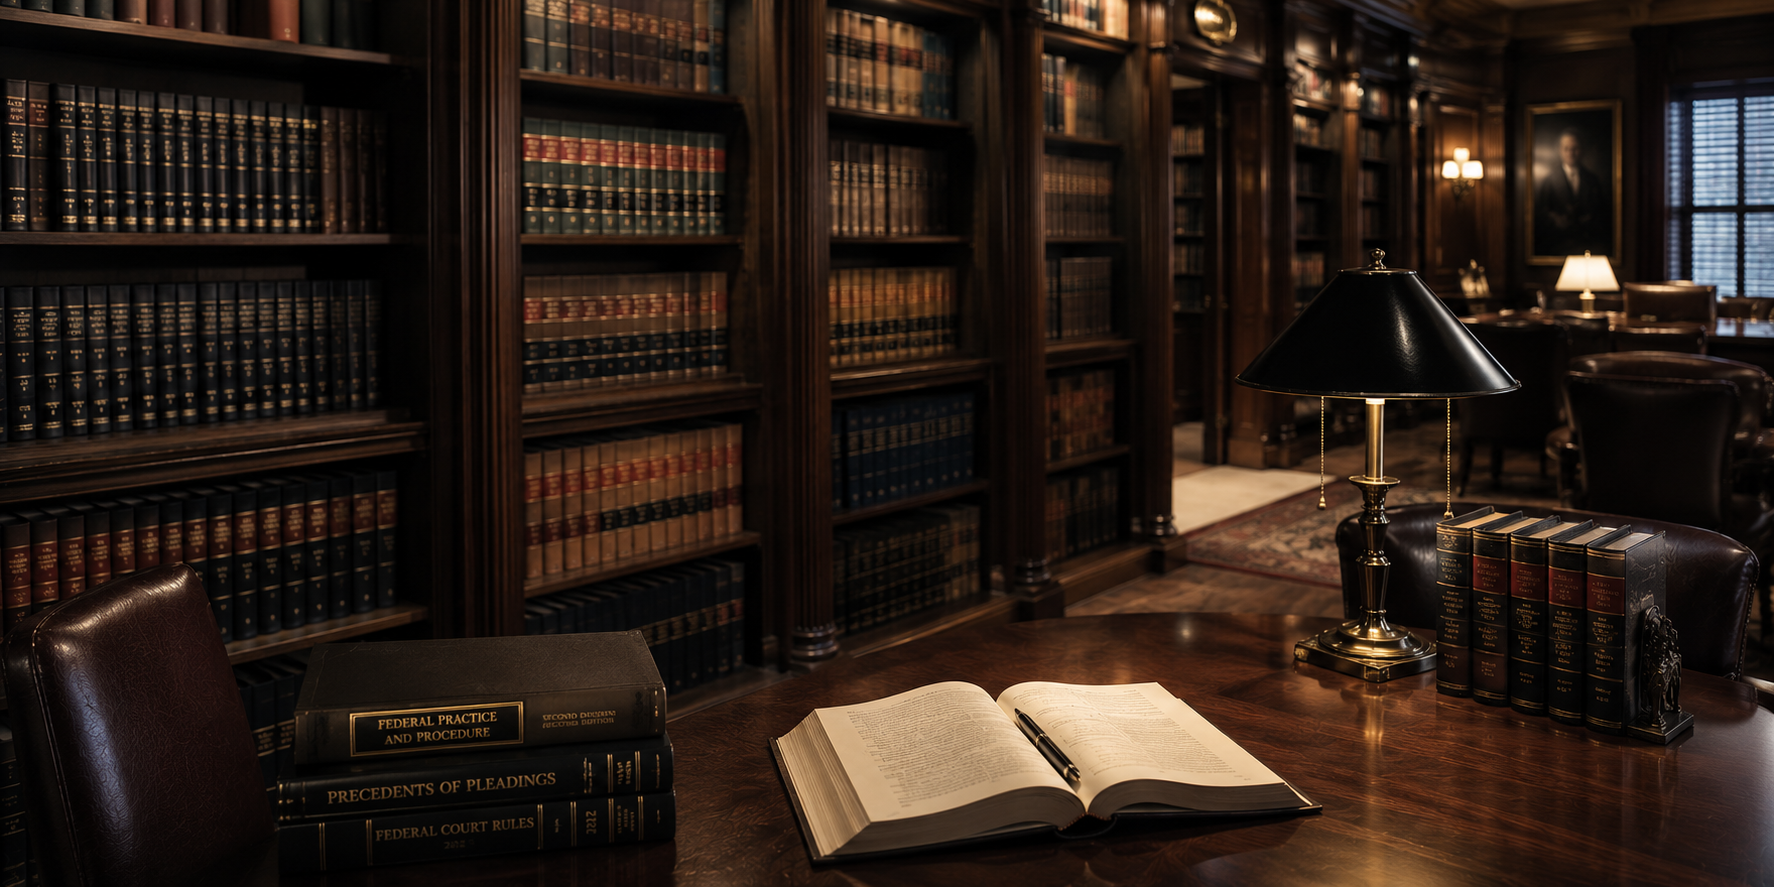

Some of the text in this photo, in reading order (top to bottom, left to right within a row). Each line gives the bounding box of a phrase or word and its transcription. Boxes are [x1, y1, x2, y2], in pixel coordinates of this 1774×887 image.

[378, 711, 498, 731] FEDERAL PRACTICE
[384, 727, 491, 746] AND PROCEDURE
[327, 772, 557, 805] PRECEDENTS OF PLEADINGS
[375, 825, 438, 842] FEDERAL
[440, 820, 488, 836] COURT
[492, 817, 535, 832] RULES
